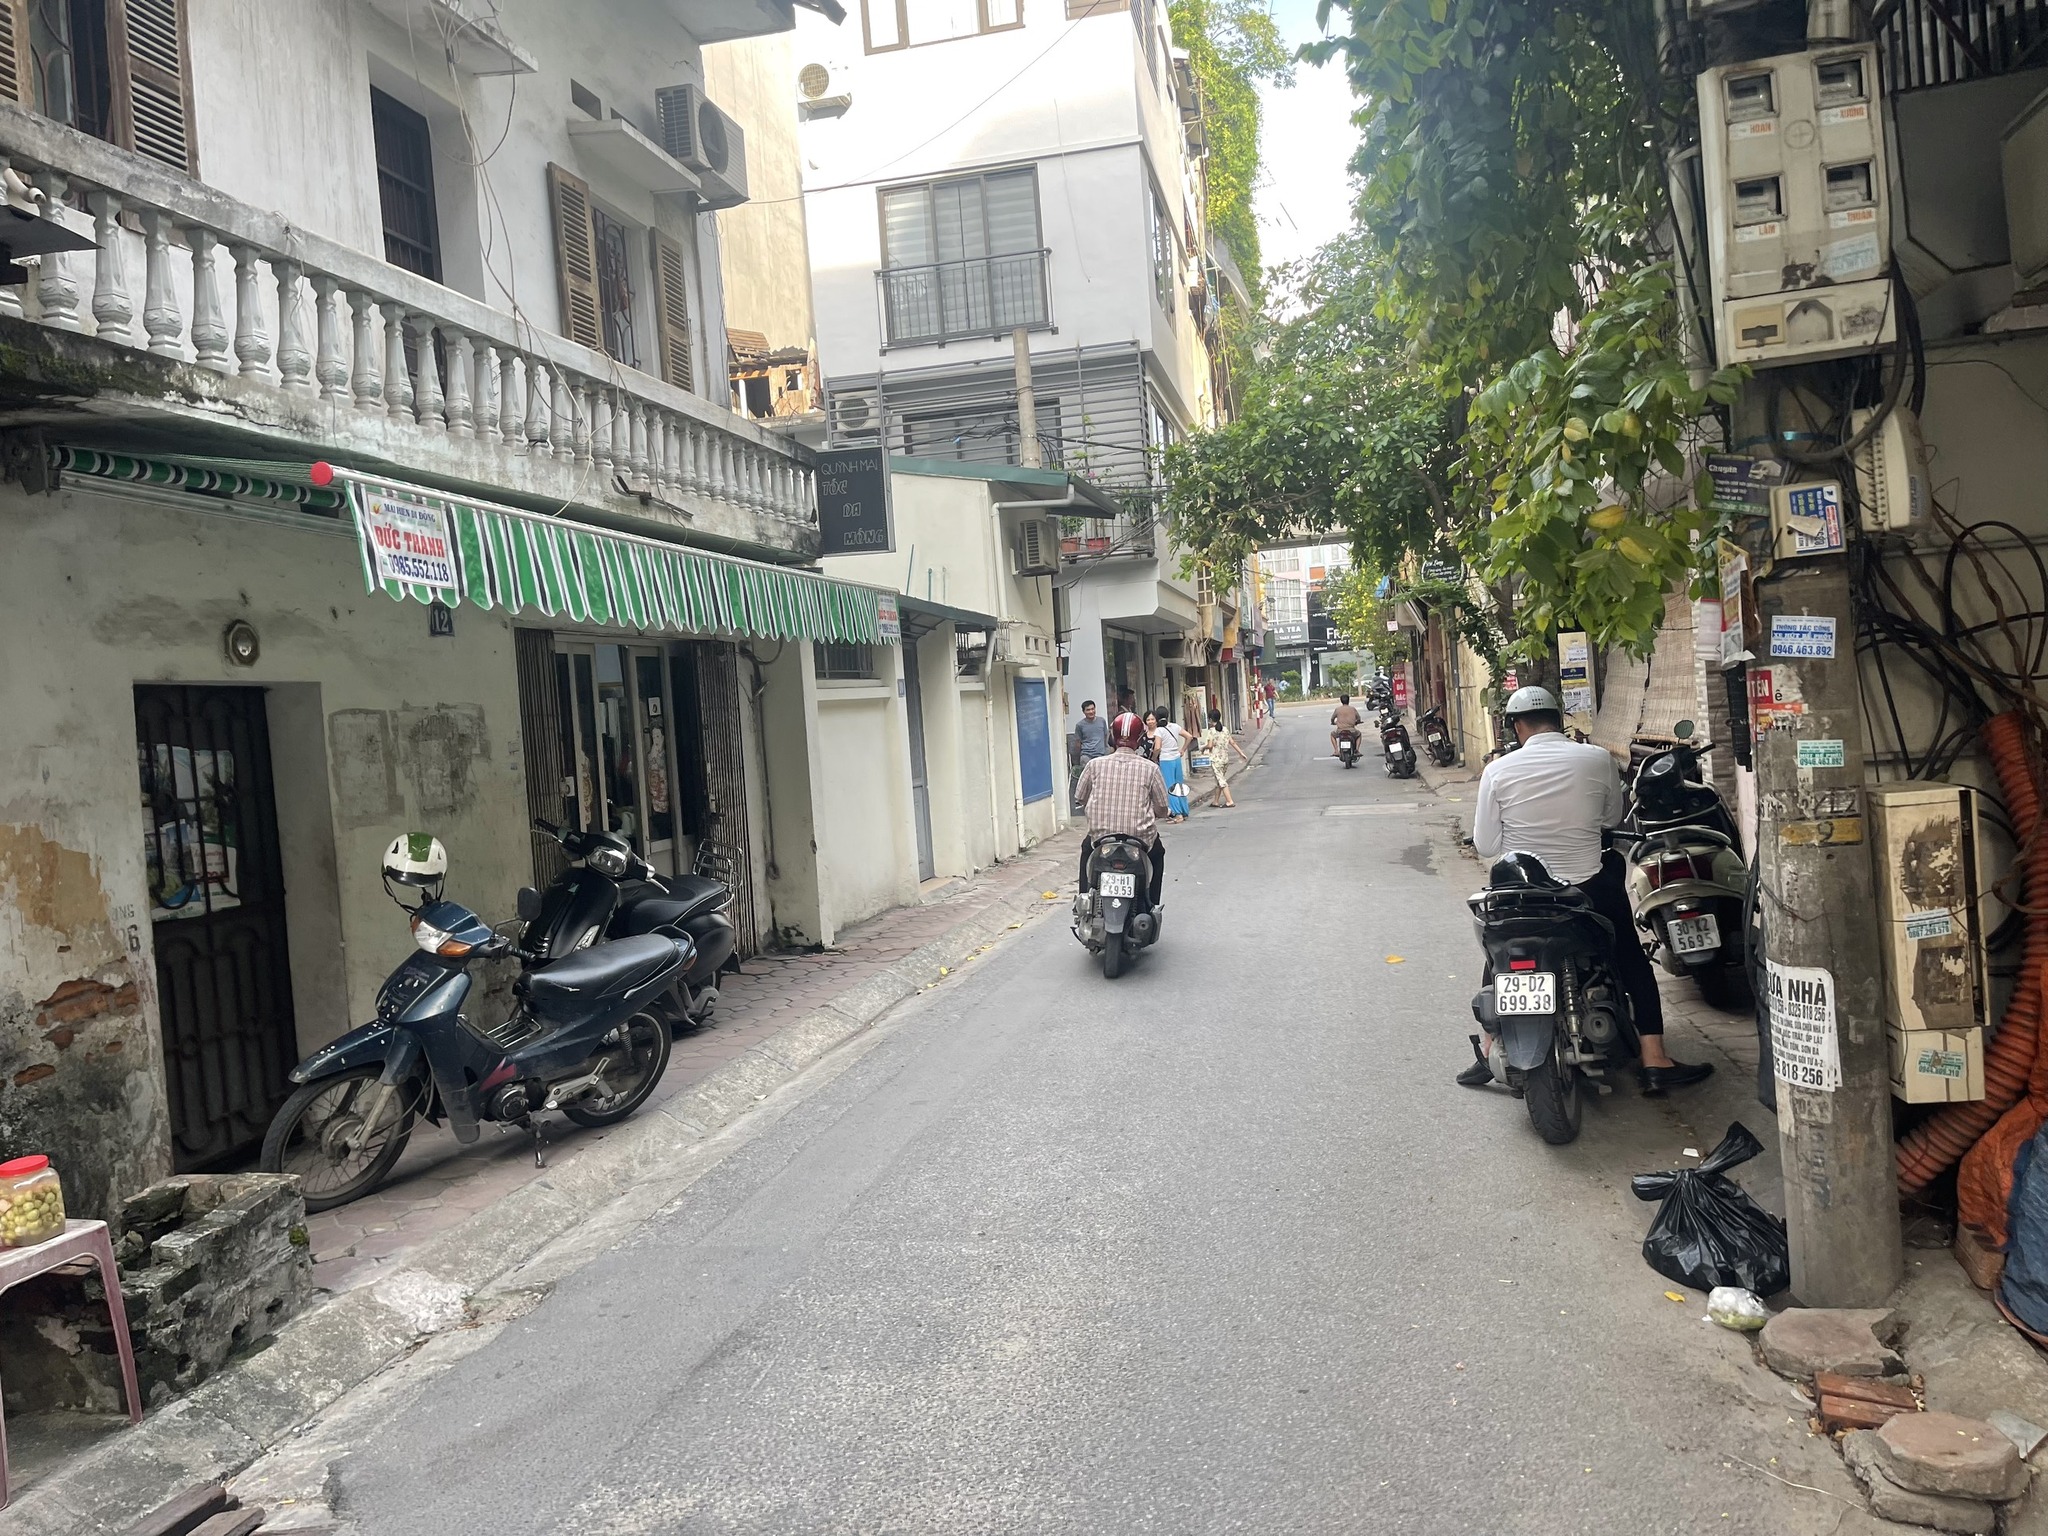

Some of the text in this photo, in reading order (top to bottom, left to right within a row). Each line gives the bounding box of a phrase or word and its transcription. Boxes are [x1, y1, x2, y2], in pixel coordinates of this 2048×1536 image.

[859, 459, 878, 471] MAI
[843, 502, 861, 518] DA
[374, 522, 445, 559] ĐỨC THÀNH
[388, 554, 450, 582] 0985.552.118
[434, 609, 449, 632] 12
[1287, 625, 1302, 633] TEA
[1772, 644, 1832, 656] 0946.463.892
[1675, 917, 1710, 936] 30-K2
[1678, 932, 1714, 951] 5695
[1504, 976, 1546, 993] 29-D2
[1788, 978, 1827, 1006] NHÀ
[1500, 994, 1551, 1011] 699.38
[1781, 1060, 1799, 1081] 818
[1801, 1066, 1824, 1087] 256
